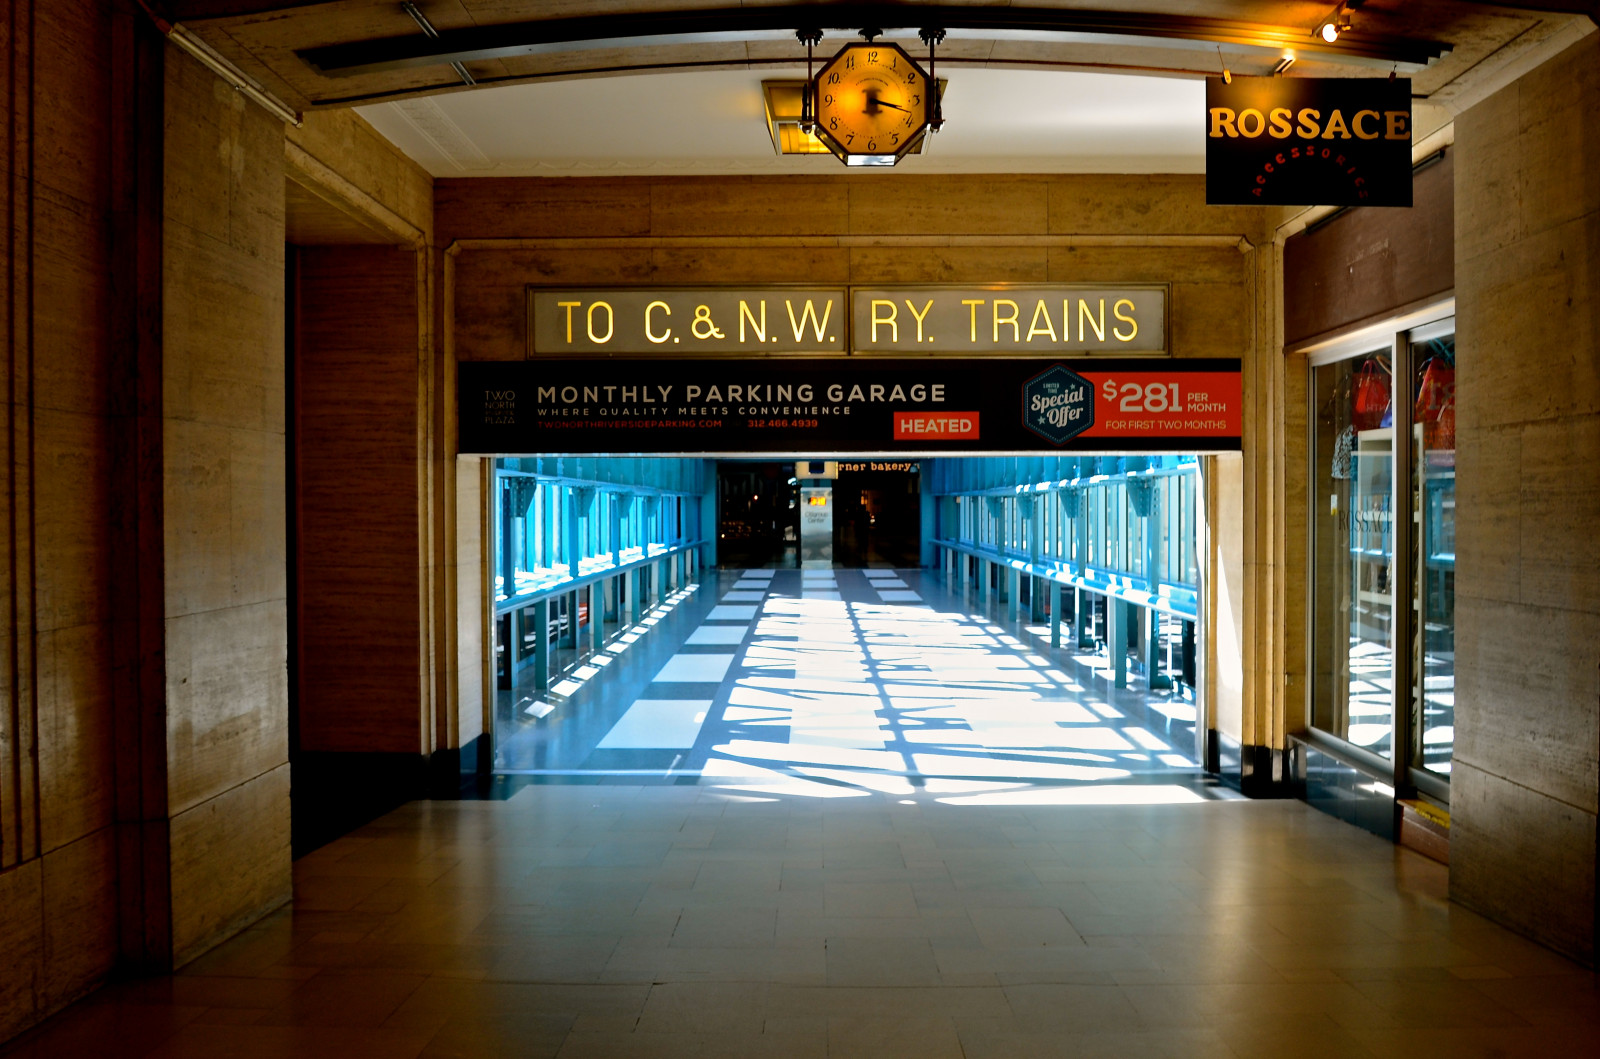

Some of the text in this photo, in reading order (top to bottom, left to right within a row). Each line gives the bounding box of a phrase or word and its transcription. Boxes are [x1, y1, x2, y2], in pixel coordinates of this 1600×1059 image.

[845, 55, 855, 69] 11
[867, 51, 878, 62] 12
[828, 72, 839, 84] 10
[907, 73, 916, 84] 2
[825, 95, 833, 107] 9
[913, 95, 920, 106] 3
[829, 117, 838, 130] 8
[905, 115, 913, 127] 4
[1209, 107, 1410, 140] ROSSACE
[845, 134, 854, 145] 7
[891, 133, 899, 145] 5
[867, 140, 876, 151] 6
[1252, 145, 1368, 199] ACCESSORIES
[558, 301, 614, 344] TO
[871, 299, 934, 343] RY.
[961, 298, 1138, 343] TRAINS
[484, 390, 516, 401] TWO
[537, 384, 945, 404] MONTHLY PARKING GARAGE
[1031, 386, 1084, 414] Special
[1103, 379, 1183, 413] $281
[1187, 393, 1208, 401] PER
[484, 401, 515, 409] NORTH
[537, 406, 851, 416] WHERE QUALITY MEETS CONVENIENCE
[1187, 403, 1226, 412] MONTH
[1046, 405, 1084, 428] Offer
[538, 419, 723, 429] TWONORTHRIVERSIDEPARKING.COM
[747, 419, 818, 428] 312.466.4939
[900, 418, 972, 433] HEATED
[1105, 420, 1227, 430] FOR FIRST TWO MONTHS
[838, 461, 912, 472] rner bakery
